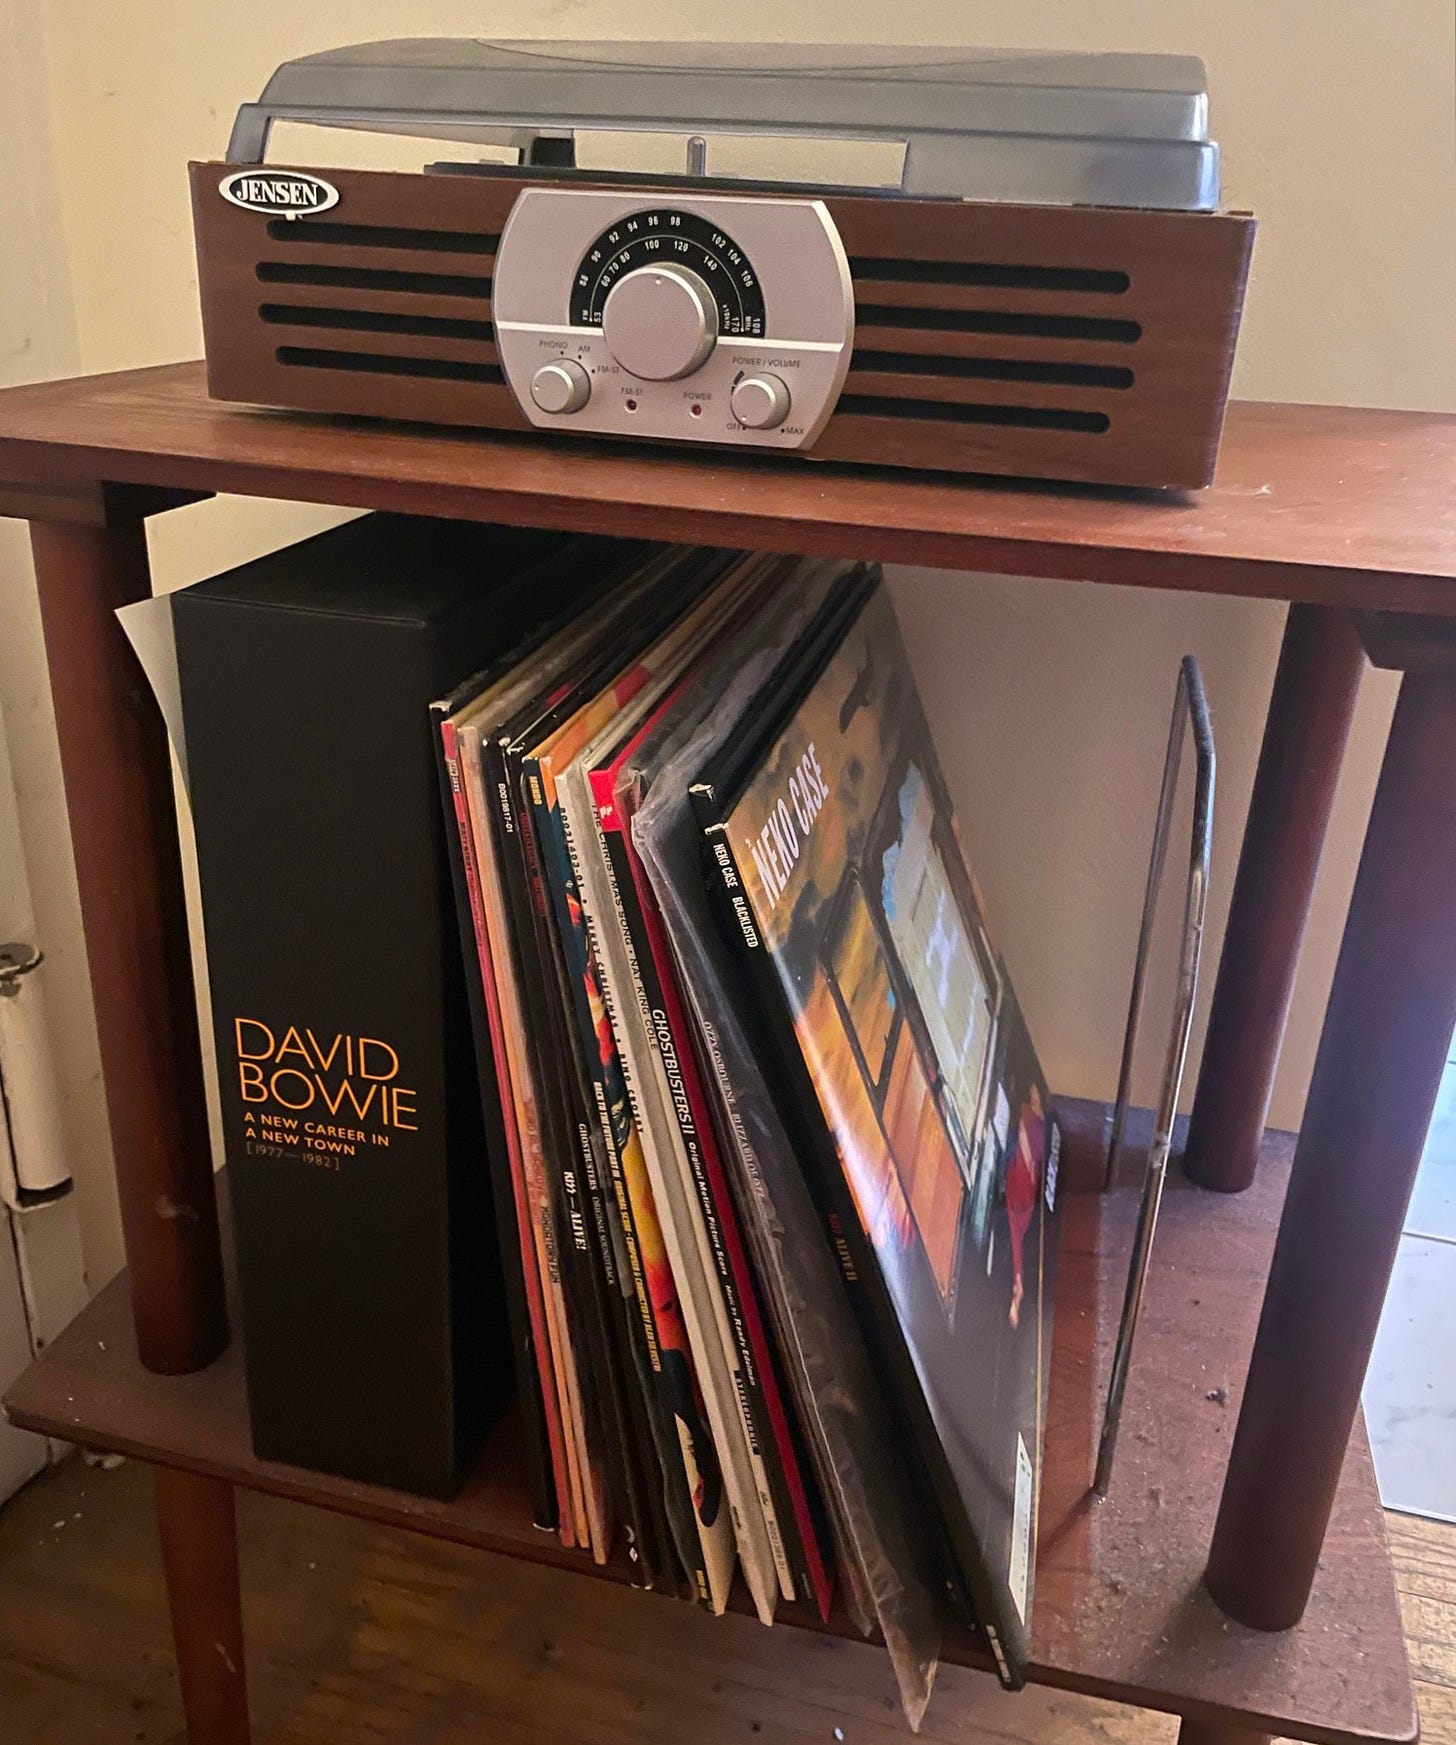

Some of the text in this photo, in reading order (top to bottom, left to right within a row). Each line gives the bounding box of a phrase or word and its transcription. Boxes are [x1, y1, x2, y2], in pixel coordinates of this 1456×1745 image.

[236, 179, 318, 206] JENSEN
[579, 274, 589, 287] 88
[591, 250, 601, 262] 90
[608, 231, 620, 244] 92
[627, 221, 638, 232] 94
[648, 215, 659, 226] 96
[670, 216, 681, 226] 98
[711, 233, 726, 248] 102
[727, 249, 741, 265] 104
[741, 270, 754, 287] 106
[752, 318, 761, 334] 108
[600, 275, 611, 287] 60
[608, 262, 620, 274] 70
[620, 251, 631, 263] 80
[645, 239, 660, 251] 100
[674, 241, 689, 252] 120
[703, 255, 718, 271] 140
[731, 317, 740, 333] 170
[538, 340, 569, 350] PHONO
[578, 345, 591, 353] AM
[732, 356, 762, 366] POWER
[768, 360, 801, 368] VOLUME
[683, 392, 712, 400] POWER
[785, 427, 804, 435] MAX
[529, 775, 543, 805] MONDO
[751, 741, 830, 911] NEKO CASE
[713, 843, 759, 949] NEKO CASE BLACKLISTED
[592, 805, 602, 828] THE
[599, 832, 624, 906] CHRISTMAS
[618, 911, 632, 946] SONG
[630, 958, 642, 980] NAT
[637, 986, 650, 1015] KING
[645, 1019, 659, 1050] COLE
[585, 915, 601, 954] MERRY
[598, 961, 619, 1028] CHRISTMAS
[619, 1053, 632, 1082] BING
[628, 1089, 645, 1133] CROSBY
[235, 1017, 399, 1081] DAVID
[652, 1009, 692, 1125] GHOSTBUSTERS
[238, 1061, 418, 1130] BOWIE
[593, 1081, 604, 1100] BACK
[597, 1101, 606, 1111] TO
[703, 1021, 718, 1049] OZZY
[713, 1049, 736, 1105] OSBOURNE
[731, 1113, 752, 1162] BLIZZARD
[244, 1111, 390, 1146] A NEW CAREER IN
[599, 1111, 609, 1123] THE
[683, 1123, 695, 1135] II
[245, 1127, 355, 1156] A NEW TOWN
[602, 1124, 615, 1151] FUTURE
[607, 1151, 619, 1169] PART
[688, 1141, 704, 1180] Original
[563, 1171, 577, 1194] KISS
[570, 1210, 587, 1250] ALIVE!
[578, 1123, 615, 1285] GHOSTBUSTERS ORIGINAL SOUNDTRACK
[613, 1180, 628, 1210] ORIGINAL
[699, 1180, 712, 1215] Motion
[709, 1216, 720, 1250] Picture
[716, 1250, 728, 1276] Score
[835, 1237, 854, 1270] ALIVE
[634, 1277, 649, 1312] CONDUCTED
[733, 1318, 746, 1349] Randy
[741, 1349, 756, 1387] Edelman
